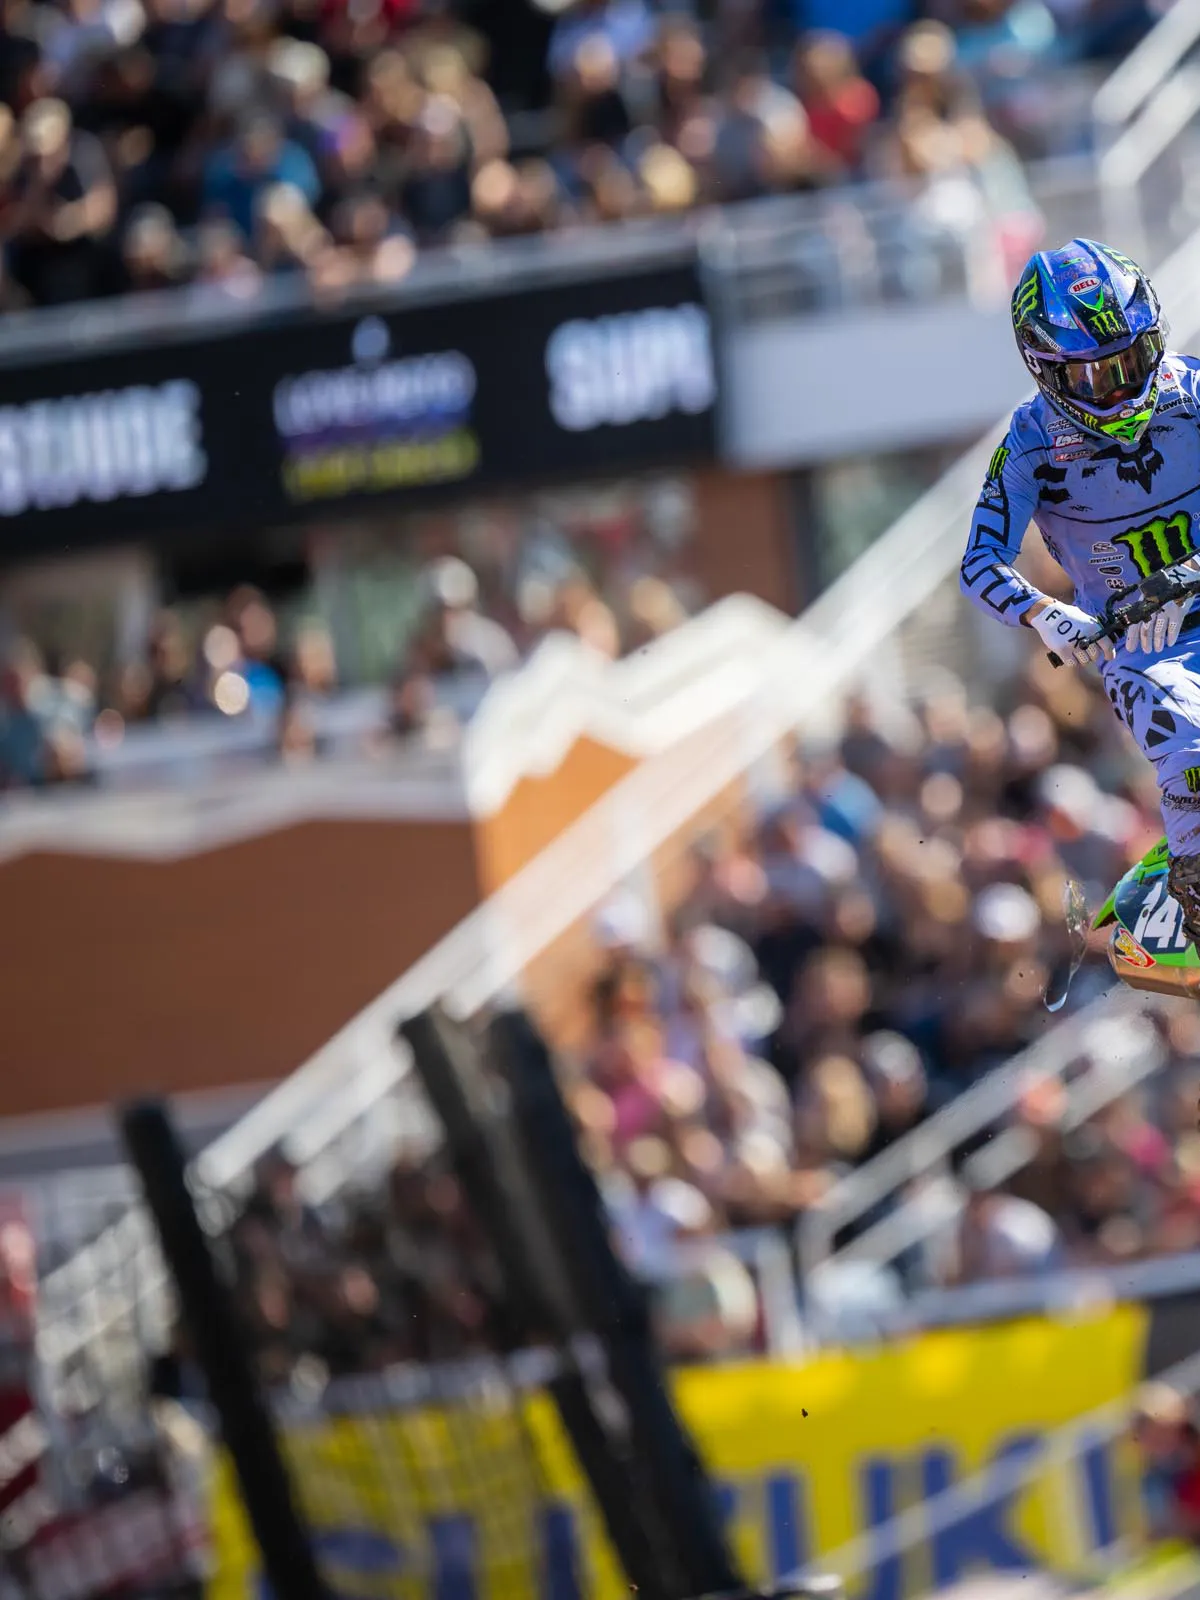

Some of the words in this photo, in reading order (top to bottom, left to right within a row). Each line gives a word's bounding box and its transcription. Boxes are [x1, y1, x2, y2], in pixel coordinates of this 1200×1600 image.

[1072, 279, 1098, 293] BELL
[1155, 396, 1193, 416] Kawasa
[1045, 609, 1087, 648] FOX
